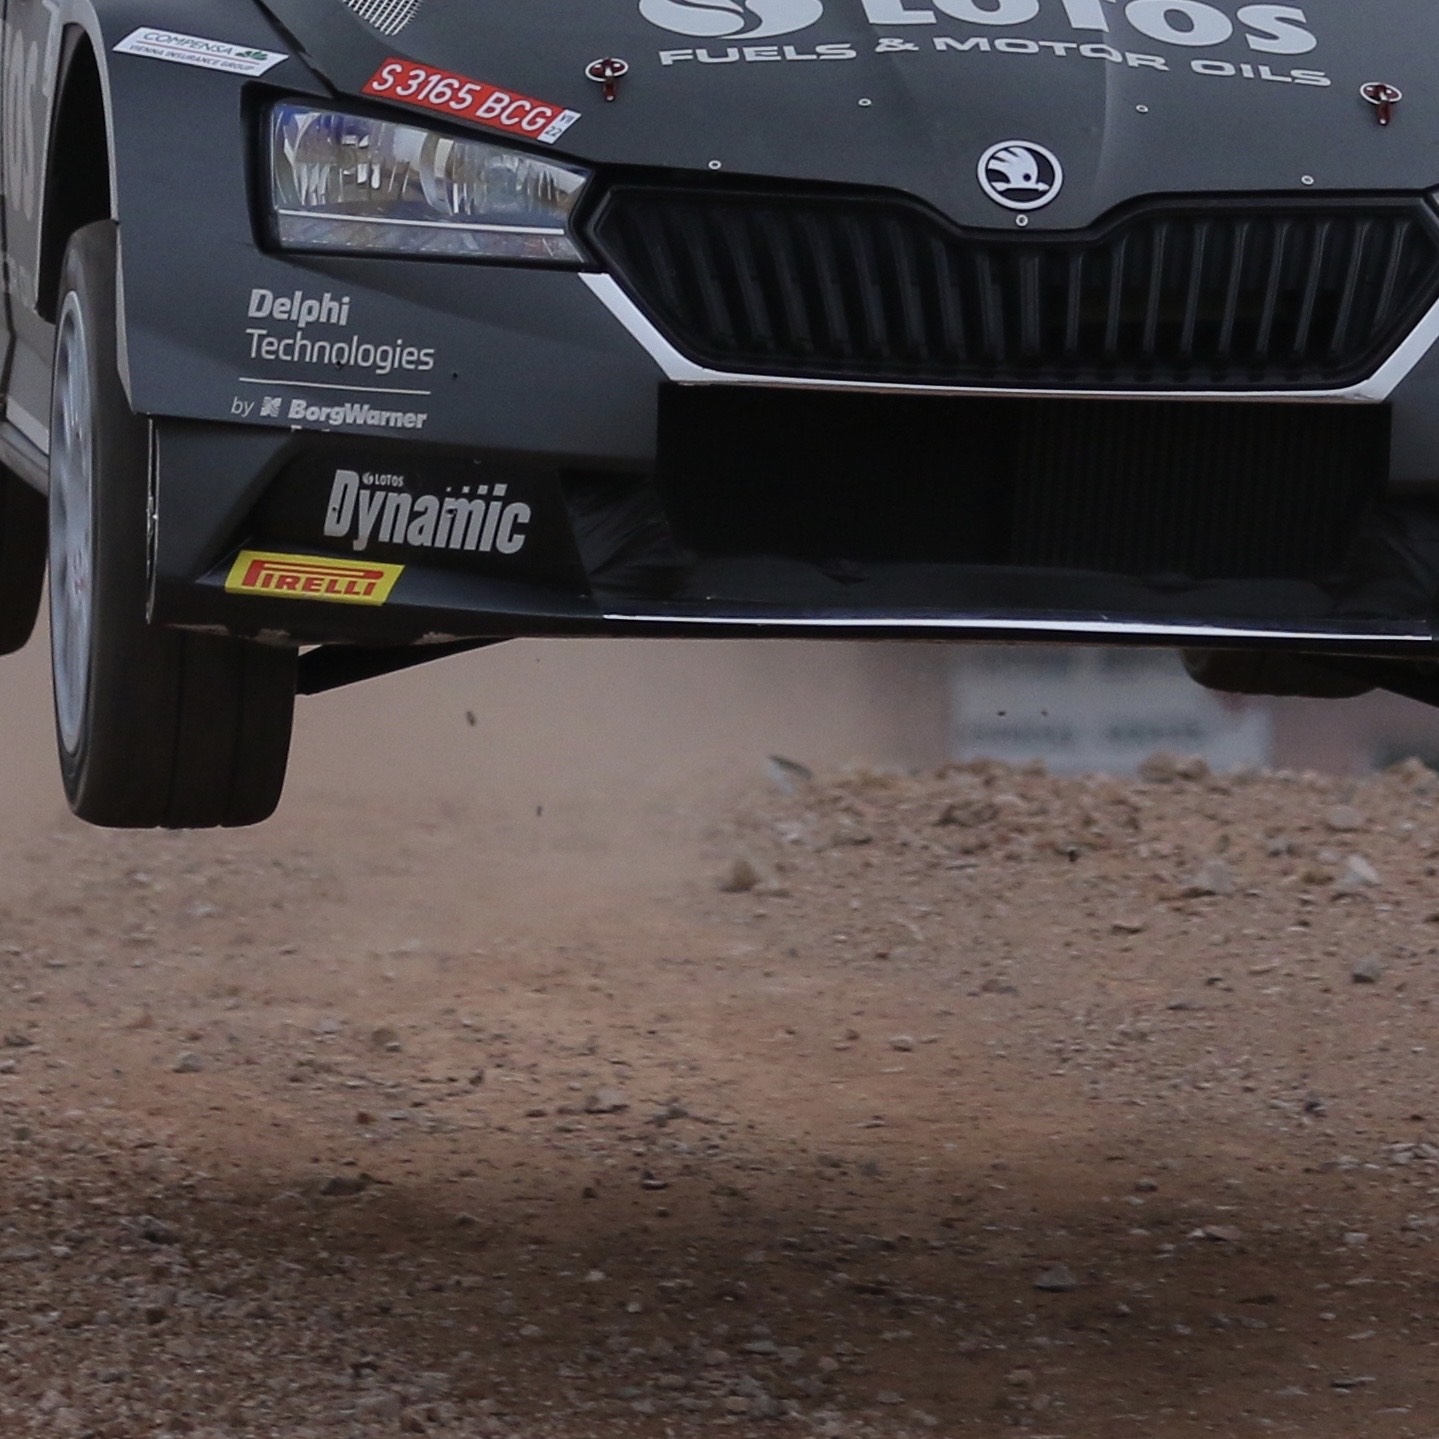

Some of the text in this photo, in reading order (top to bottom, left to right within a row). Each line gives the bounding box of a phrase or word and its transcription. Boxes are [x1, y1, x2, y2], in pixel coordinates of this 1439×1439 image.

[129, 44, 256, 72] VIENNA INSURANCE GROUP
[143, 32, 233, 55] COMPENSA
[659, 36, 1333, 87] FUELS & MOTOR OILS
[372, 64, 553, 132] S 3165 BCG
[248, 289, 350, 328] Delphi
[245, 328, 435, 375] Technologies
[231, 397, 428, 429] by BorgWarner
[375, 474, 405, 487] LOTOS
[323, 469, 531, 554] Dynamic
[242, 559, 384, 597] PIRELLI
